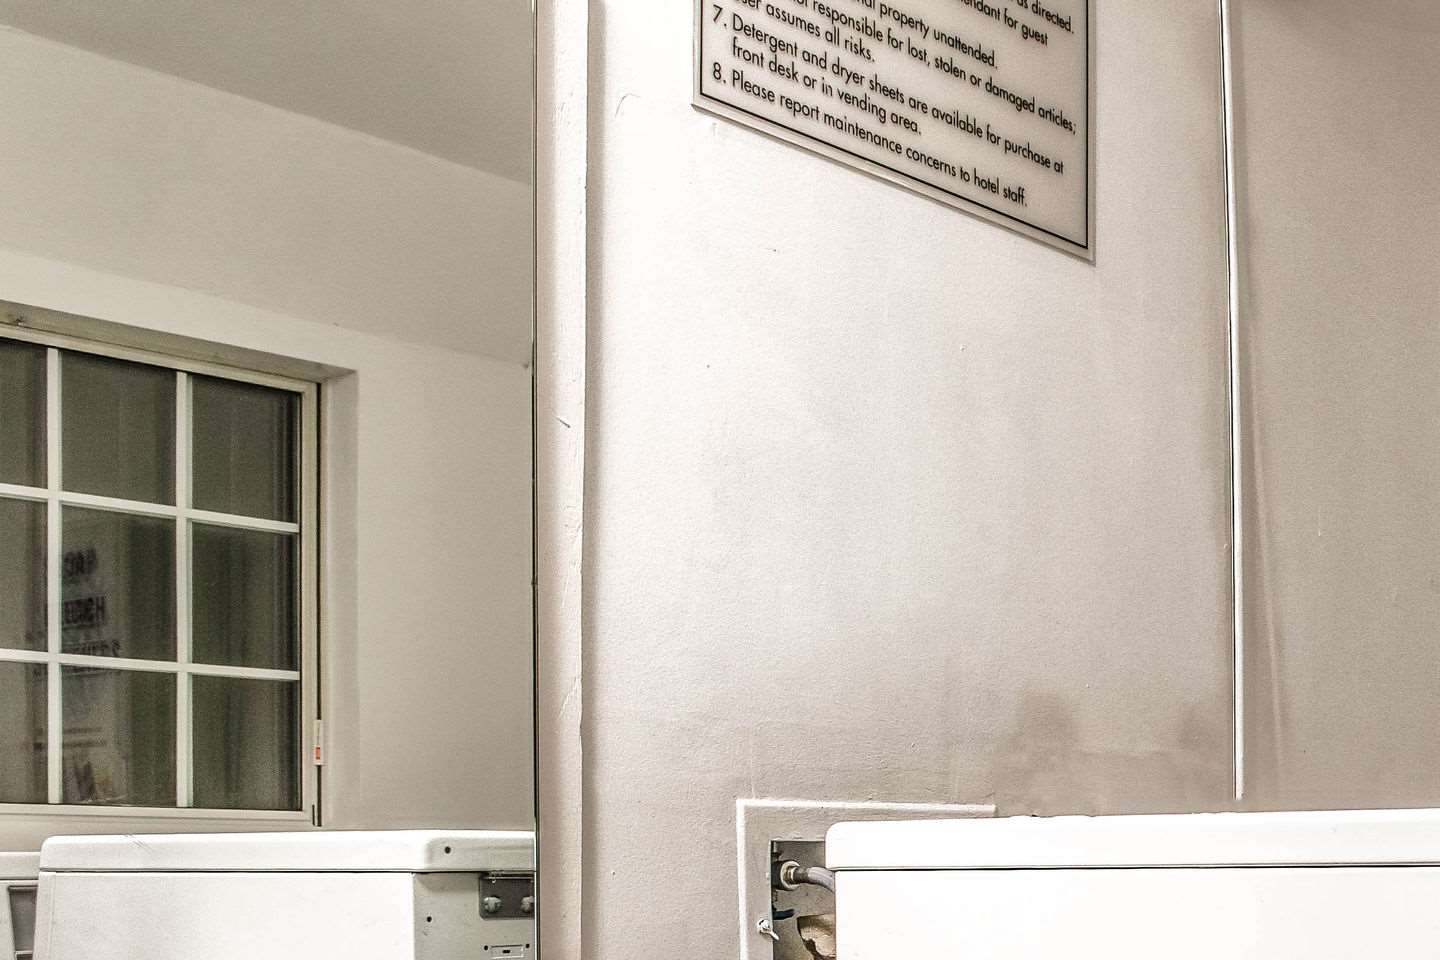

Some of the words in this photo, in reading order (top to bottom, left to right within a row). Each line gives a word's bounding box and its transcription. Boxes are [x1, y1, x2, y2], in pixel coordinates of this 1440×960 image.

[766, 4, 821, 38] assumes
[825, 27, 840, 46] all
[845, 37, 876, 63] risks.
[880, 3, 930, 39] property
[933, 28, 998, 69] unattended.
[961, 0, 1000, 21] endant
[1003, 8, 1018, 29] for
[1021, 25, 1048, 46] guest
[1031, 1, 1074, 34] directed.
[713, 4, 727, 27] 7.
[732, 14, 799, 57] Detergent
[802, 49, 827, 69] and
[831, 57, 866, 85] dryer
[869, 73, 905, 104] sheets
[909, 96, 928, 114] are
[932, 106, 983, 138] available
[985, 124, 1001, 146] for
[1004, 139, 1051, 169] purchase
[1053, 161, 1064, 175] at
[732, 37, 765, 67] front
[768, 54, 799, 82] desk
[803, 74, 818, 89] or
[822, 78, 833, 97] in
[837, 88, 887, 124] vending
[890, 112, 922, 136] area.
[812, 0, 884, 42] responsible
[887, 27, 905, 51] for
[908, 37, 931, 67] lost,
[934, 56, 966, 81] stolen
[970, 73, 983, 88] or
[985, 76, 1035, 113] damaged
[1038, 105, 1077, 136] articles;
[712, 62, 726, 84] 8.
[732, 69, 776, 103] Please
[780, 94, 820, 121] report
[824, 112, 902, 155] maintenance
[906, 147, 957, 177] concerns
[959, 167, 971, 182] to
[973, 168, 1000, 195] hotel
[1003, 186, 1028, 207] staff.
